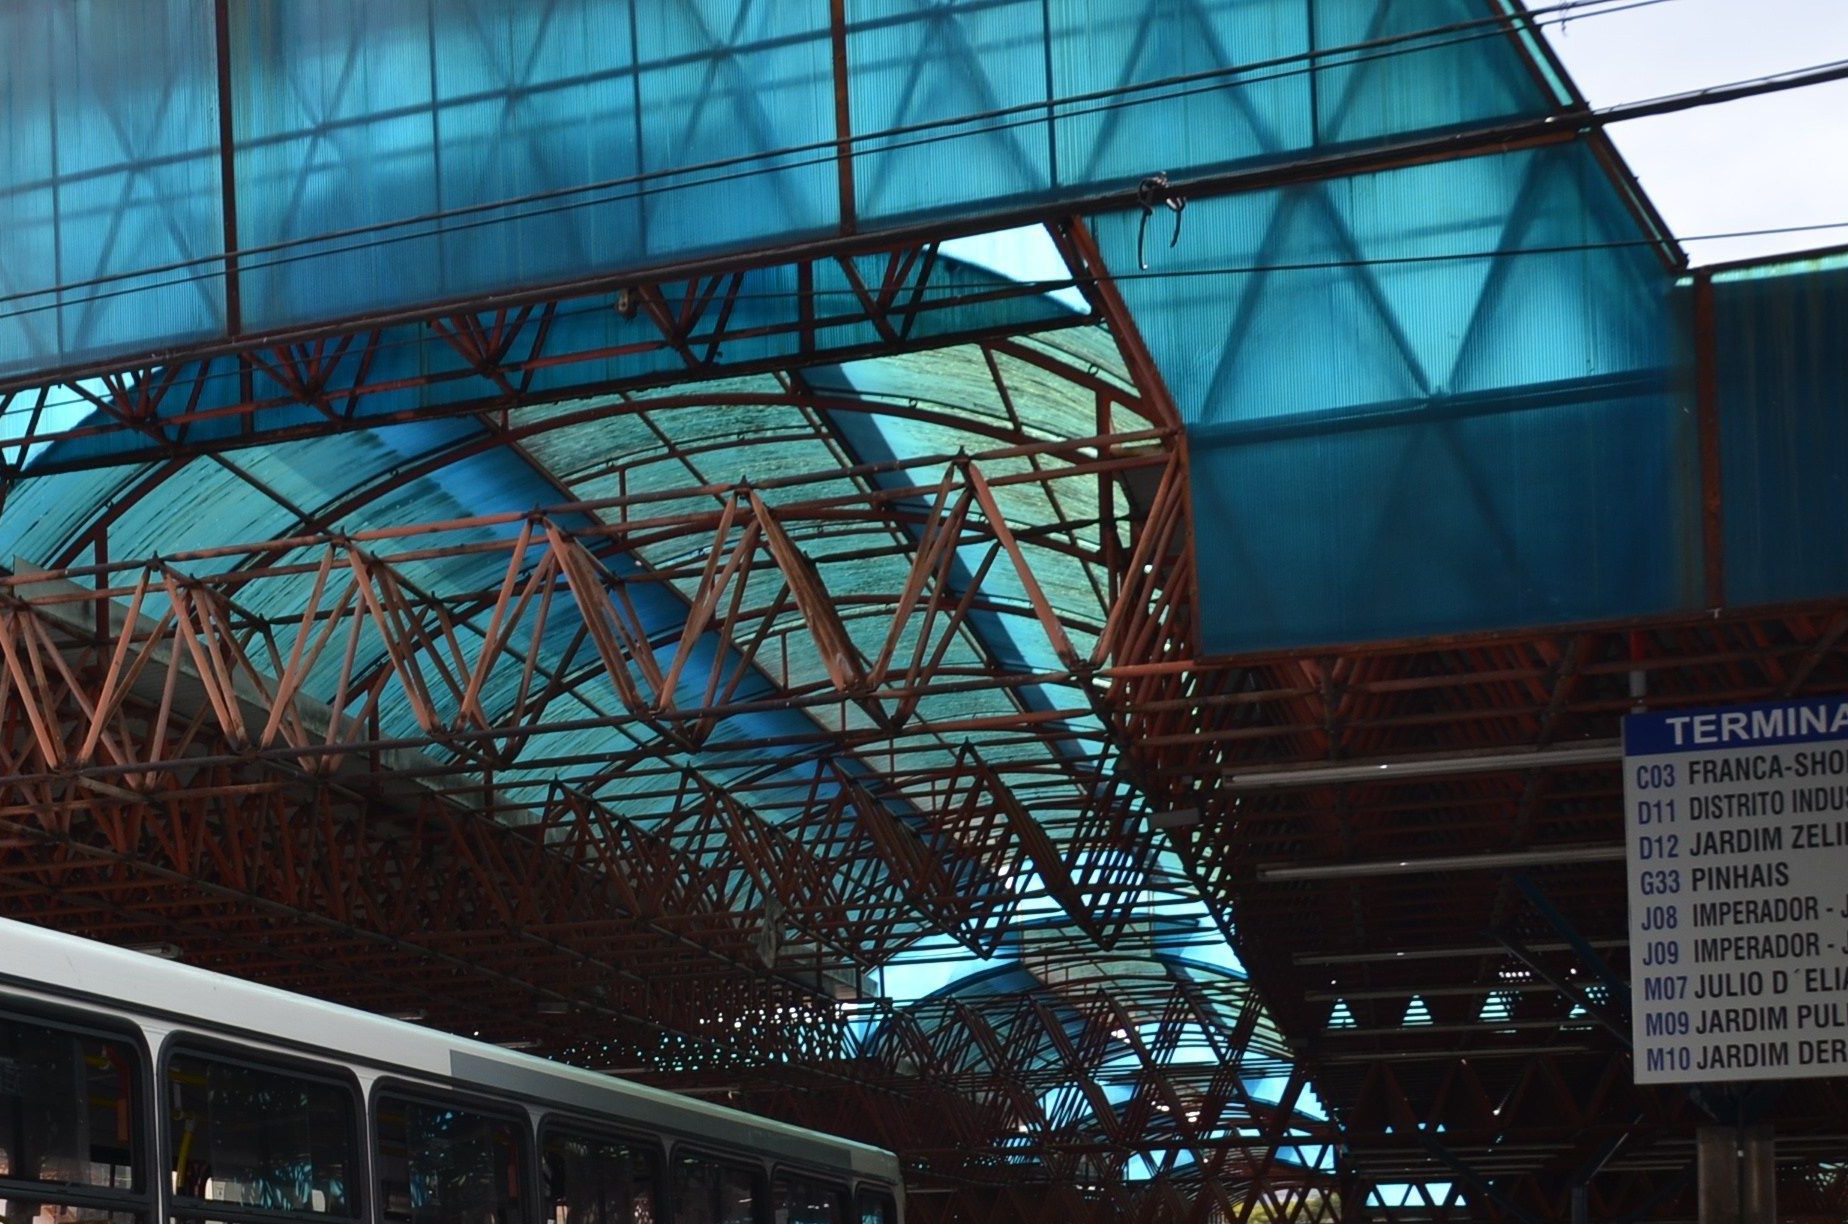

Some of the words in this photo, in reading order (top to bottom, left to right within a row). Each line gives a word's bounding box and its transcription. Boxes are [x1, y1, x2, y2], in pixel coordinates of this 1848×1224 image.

[1637, 764, 1675, 790] C03
[1689, 749, 1848, 785] FRANCA-SHO
[1639, 799, 1675, 825] D11
[1690, 790, 1784, 821] DISTRITO
[1640, 834, 1679, 860] D12
[1690, 826, 1782, 856] JARDIM
[1791, 821, 1848, 849] ZELI
[1641, 870, 1680, 895] G33
[1692, 862, 1789, 892] PINHAIS
[1641, 905, 1678, 931] J08
[1693, 896, 1819, 927] IMPERADOR
[1643, 940, 1679, 966] J09
[1694, 932, 1820, 963] IMPERADOR
[1644, 976, 1688, 1001] M07
[1695, 971, 1763, 999] JULIO
[1646, 1011, 1690, 1036] M09
[1696, 1005, 1788, 1035] JARDIM
[1797, 1003, 1848, 1030] PUL
[1647, 1047, 1691, 1071] M10
[1697, 1041, 1789, 1070] JARDIM
